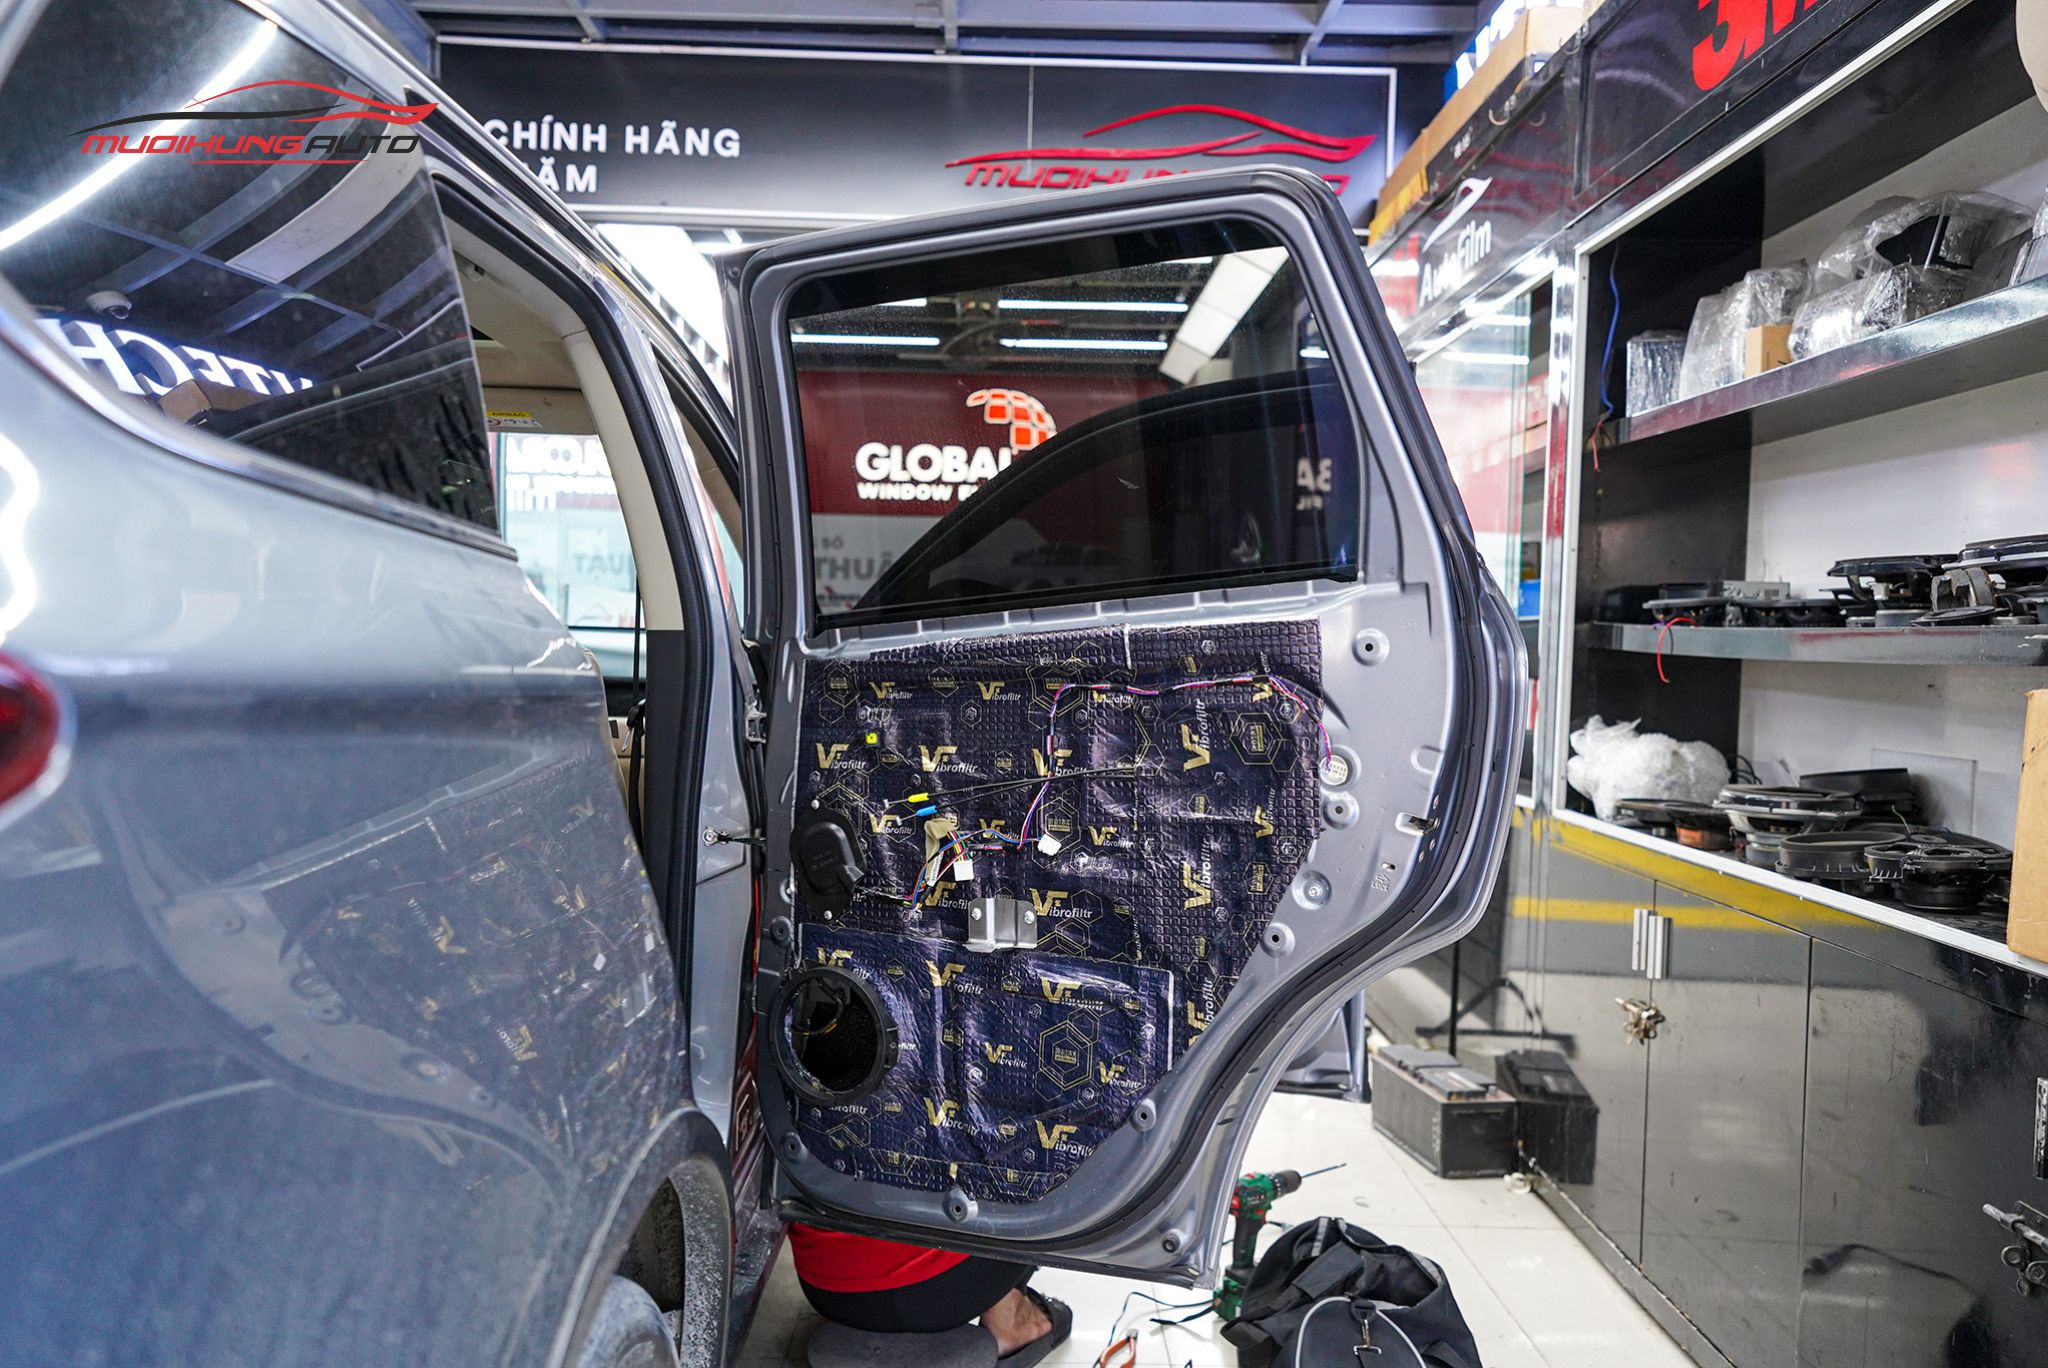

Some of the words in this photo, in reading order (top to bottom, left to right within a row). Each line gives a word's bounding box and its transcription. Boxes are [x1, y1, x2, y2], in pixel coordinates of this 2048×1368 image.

[483, 115, 607, 152] CHÍNH
[625, 120, 741, 157] HÃNG
[524, 156, 598, 193] ĂM
[857, 482, 953, 502] WINDOW
